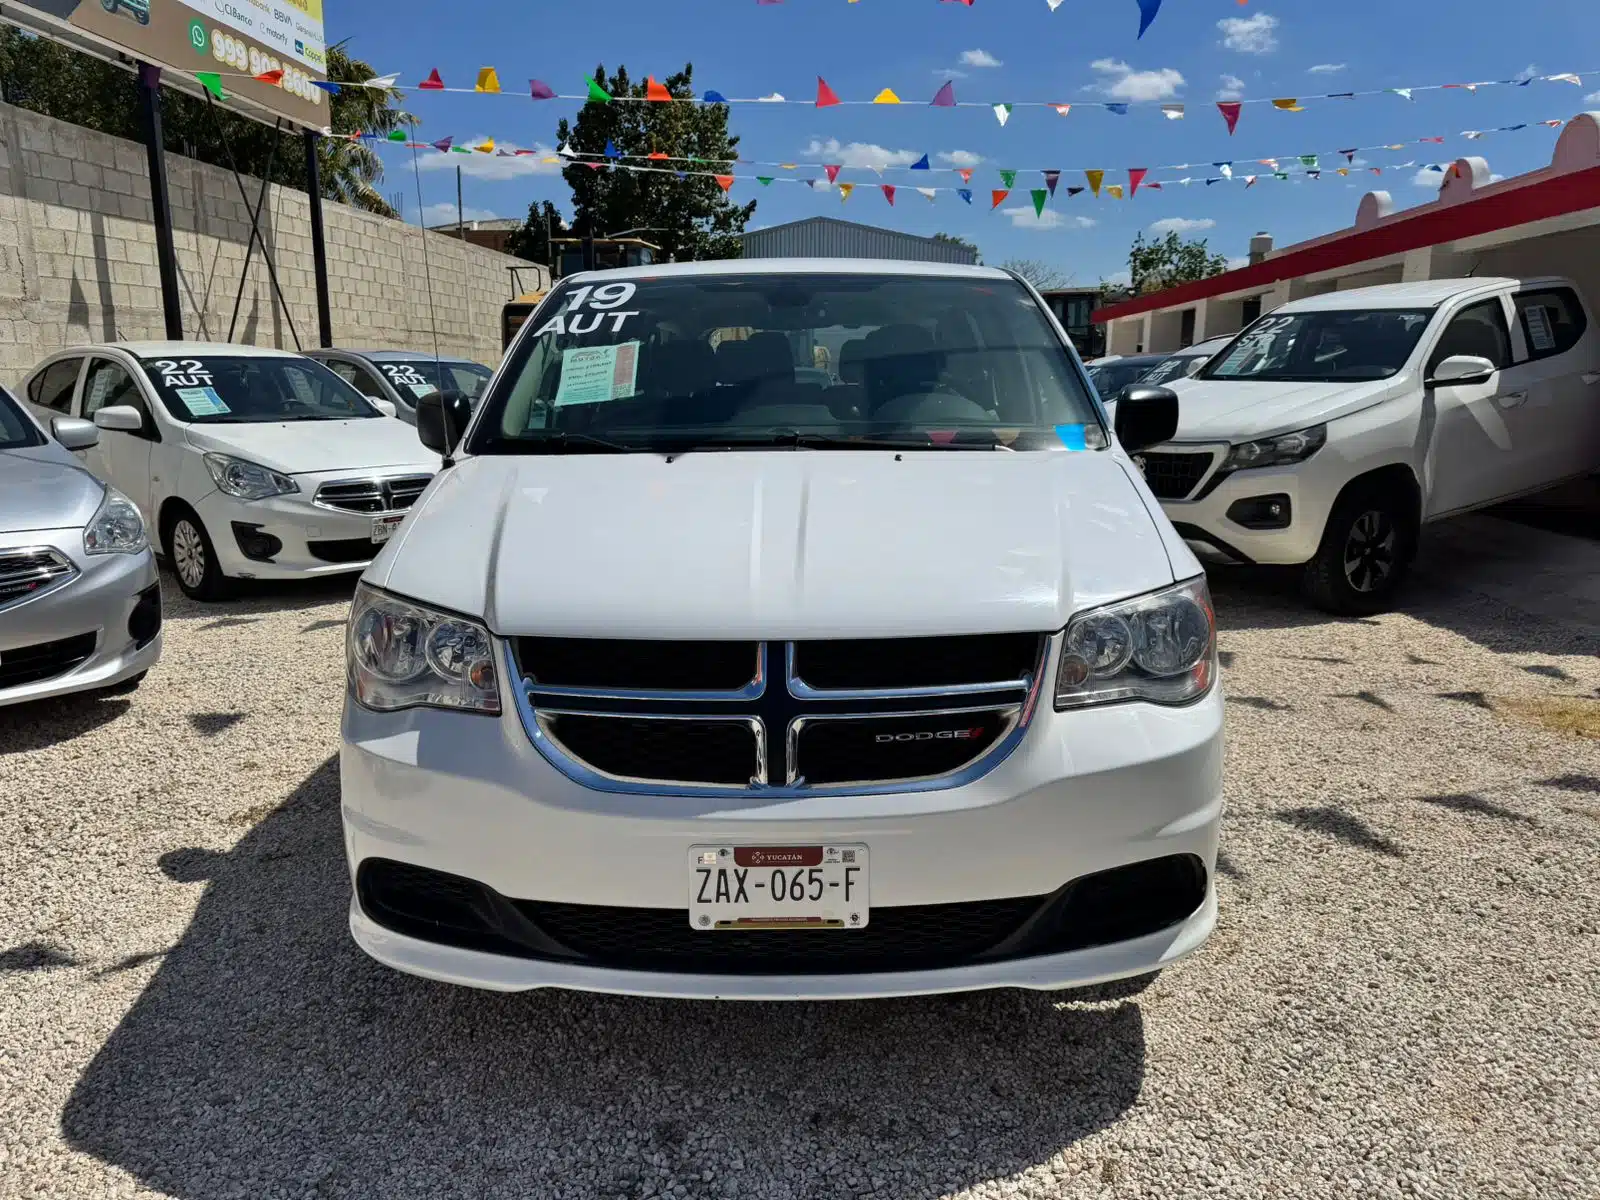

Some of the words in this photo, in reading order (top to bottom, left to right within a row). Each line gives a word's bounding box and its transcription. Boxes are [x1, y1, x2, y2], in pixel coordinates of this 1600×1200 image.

[273, 8, 292, 27] BBVA
[211, 29, 249, 71] 999
[565, 282, 637, 312] 19
[532, 310, 640, 338] AUT
[1249, 316, 1295, 335] 22
[155, 360, 210, 375] 22
[382, 364, 421, 377] 22
[165, 374, 213, 388] AUT
[393, 375, 427, 386] AUT
[875, 730, 971, 742] DODGE
[696, 867, 861, 904] ZAX-065-F
